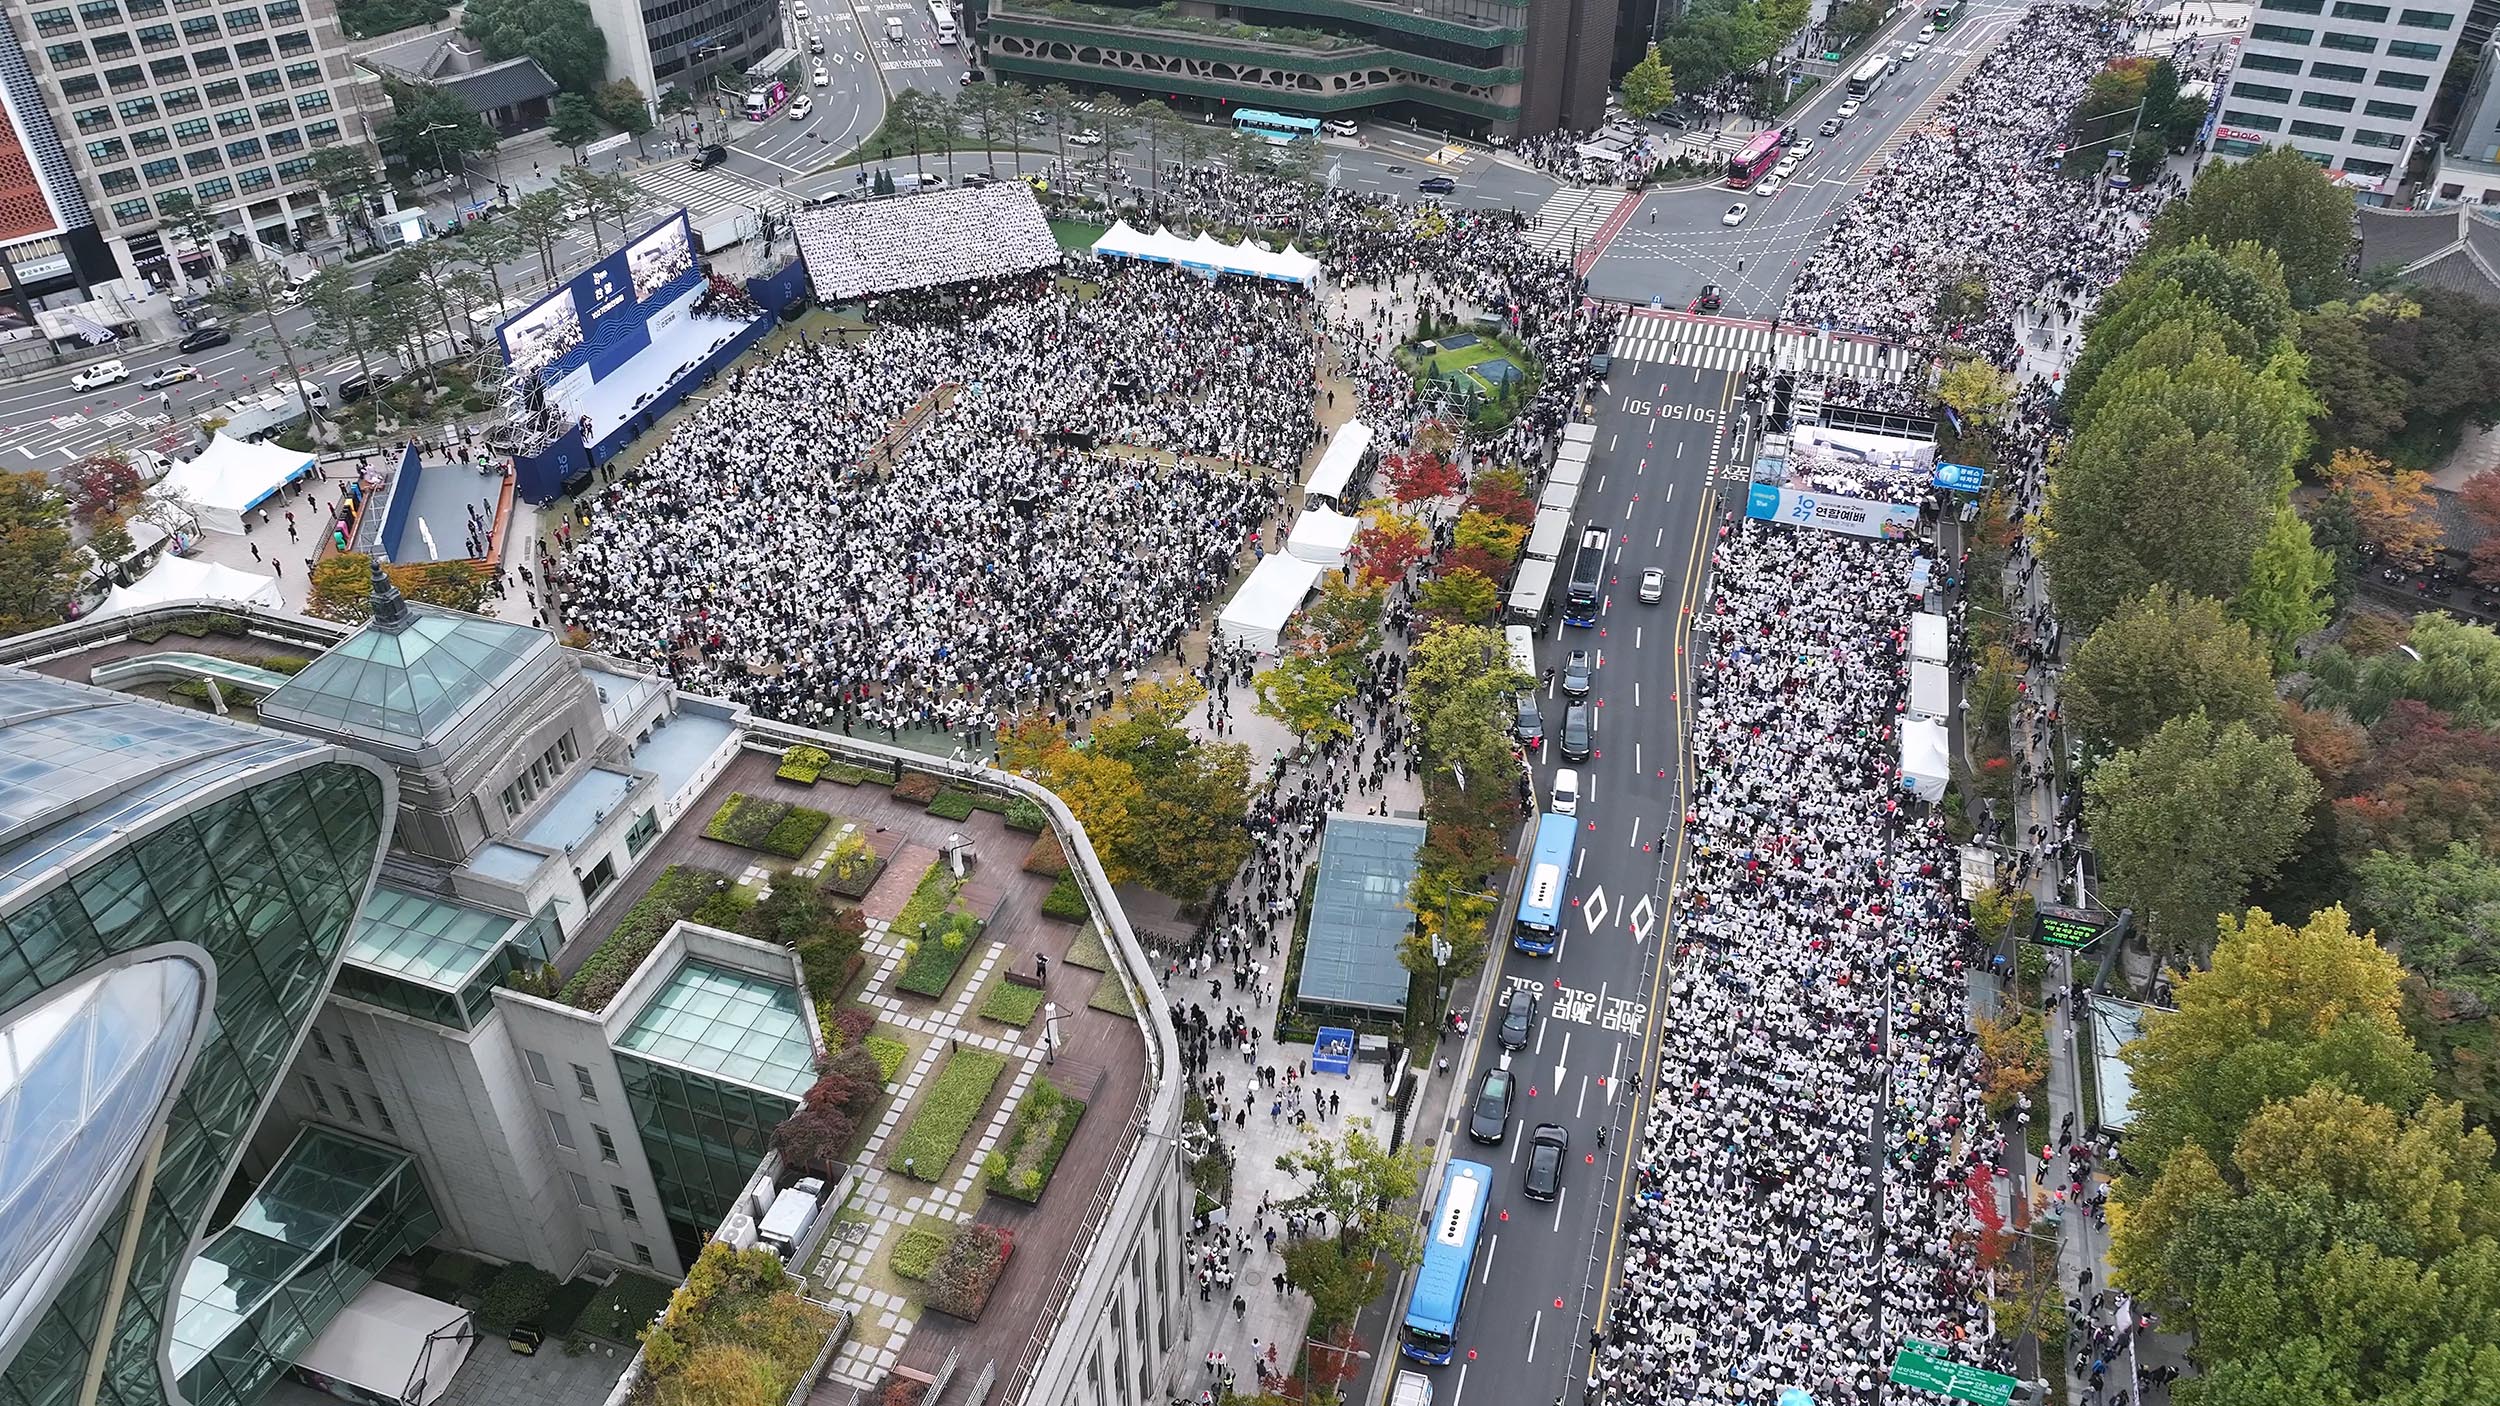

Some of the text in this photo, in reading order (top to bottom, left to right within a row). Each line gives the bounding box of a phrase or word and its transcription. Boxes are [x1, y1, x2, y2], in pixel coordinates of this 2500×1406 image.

[2224, 46, 2237, 67] 다이소
[2230, 130, 2262, 142] 다이소
[1629, 399, 1652, 416] 50
[1661, 404, 1684, 420] 50
[1693, 407, 1716, 424] 50
[1798, 495, 1815, 509] 10
[1792, 507, 1811, 522] 27
[1815, 506, 1867, 523] 연합예배
[1551, 985, 1598, 1025] 광화문
